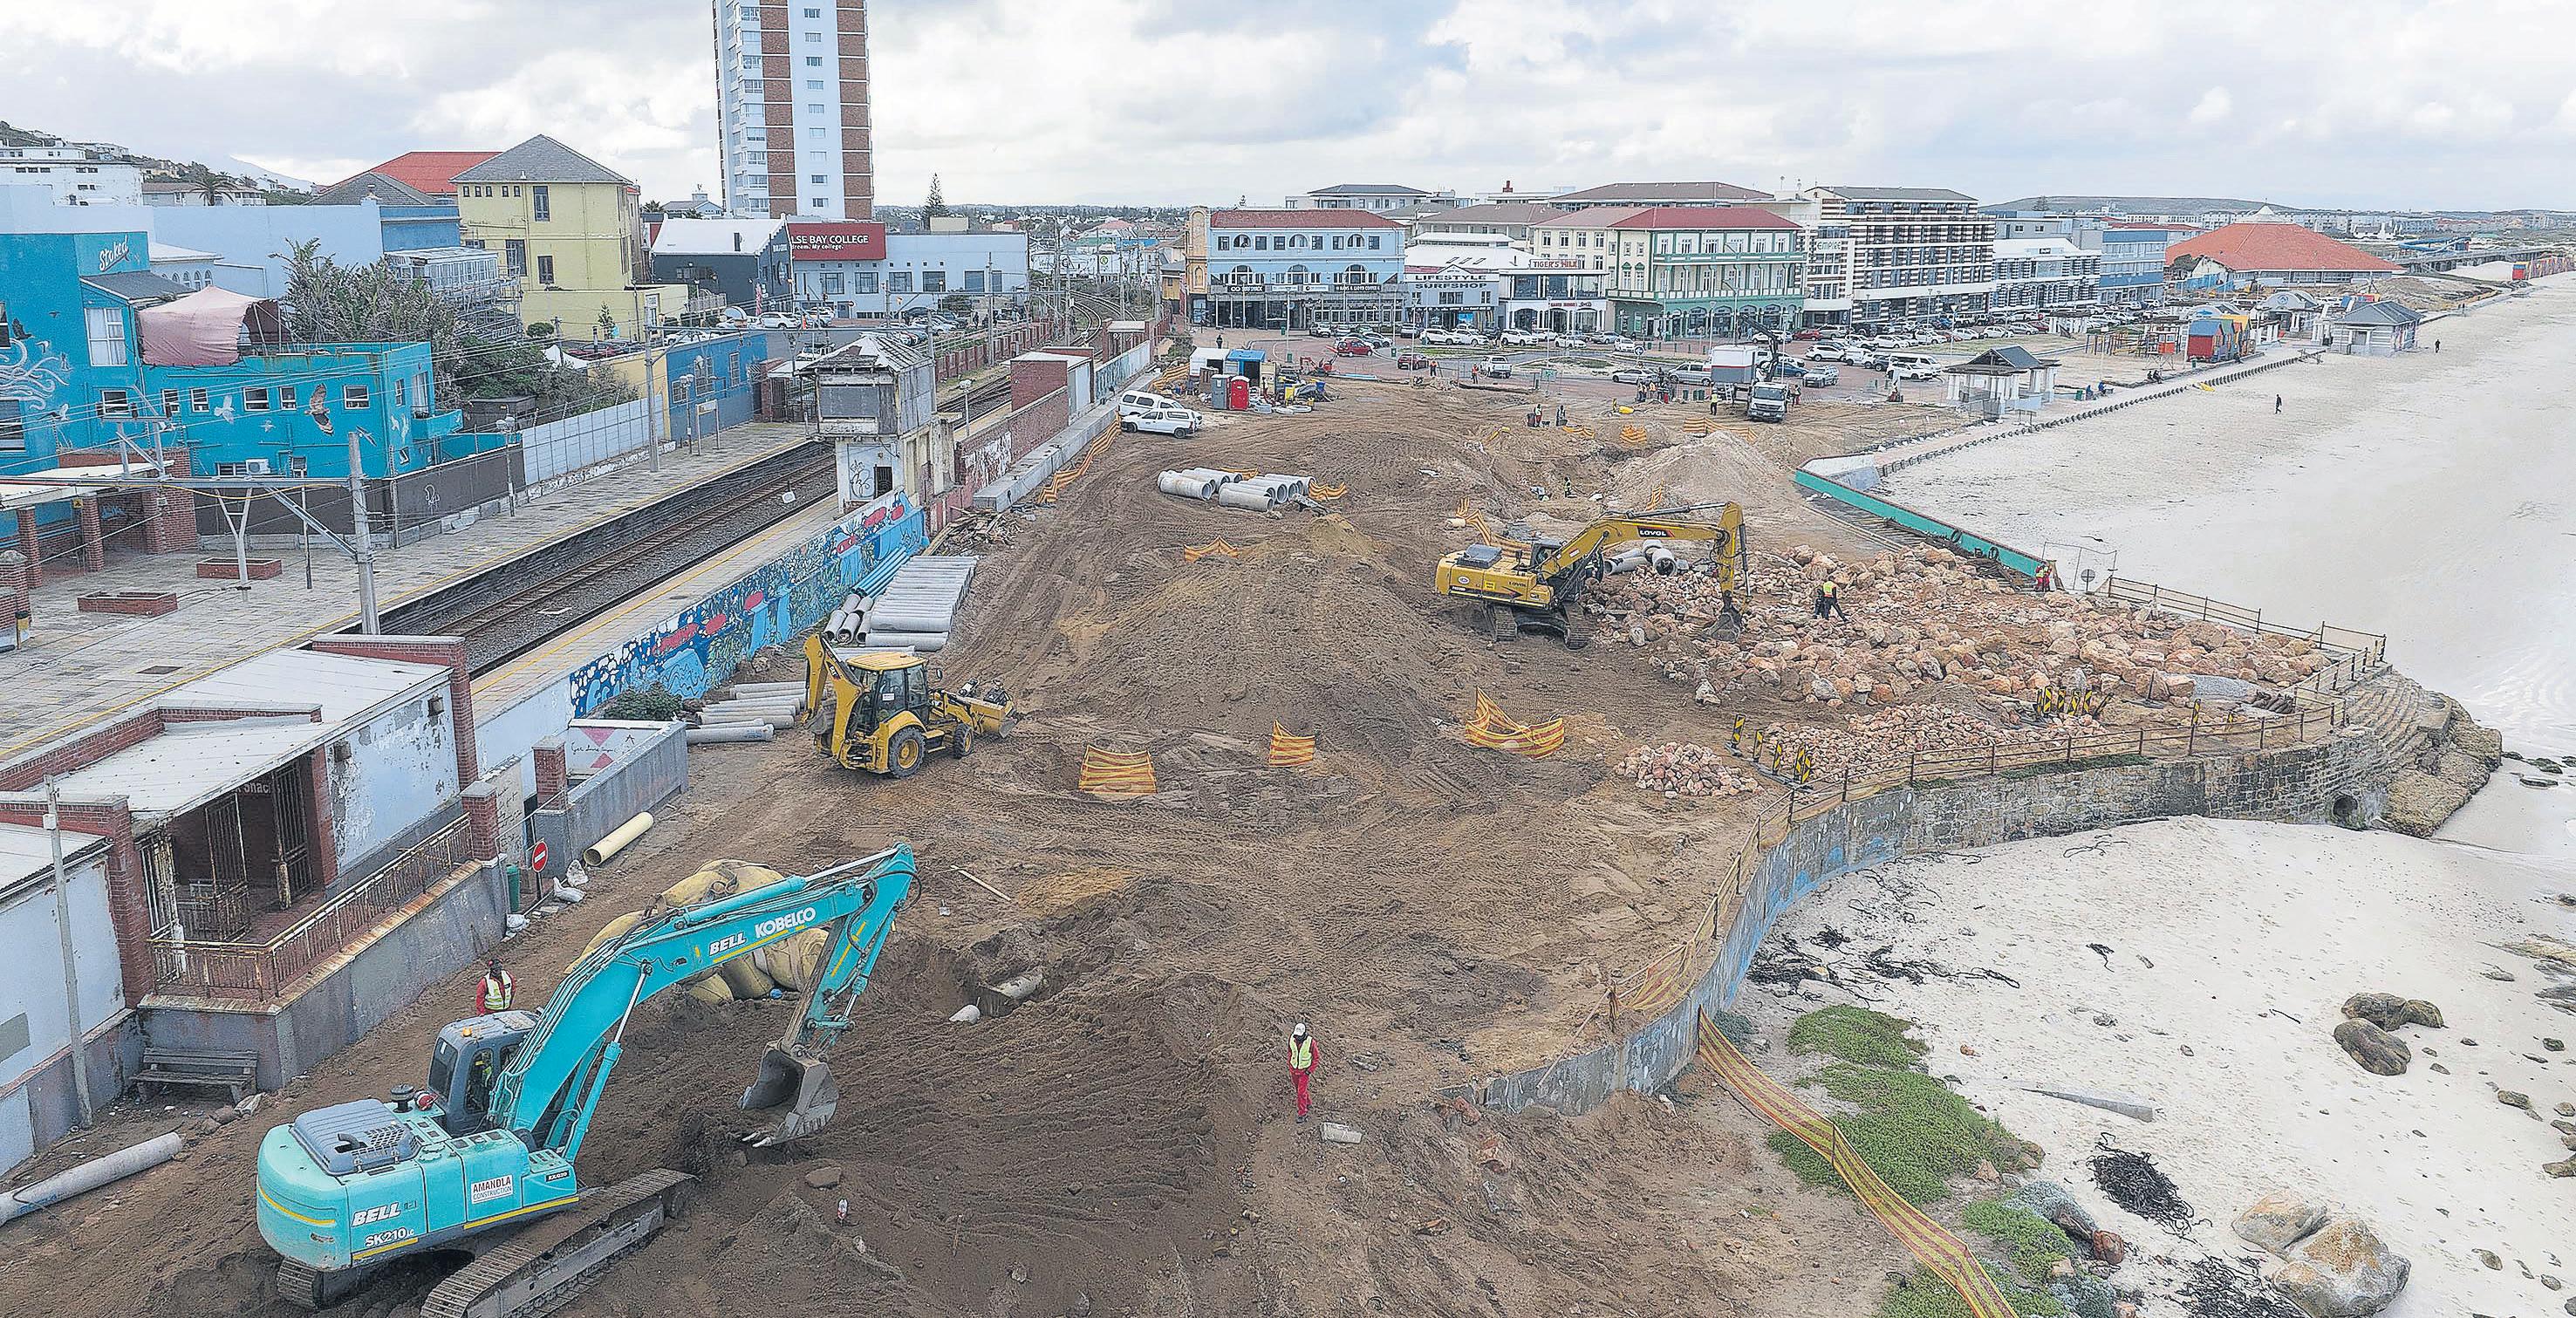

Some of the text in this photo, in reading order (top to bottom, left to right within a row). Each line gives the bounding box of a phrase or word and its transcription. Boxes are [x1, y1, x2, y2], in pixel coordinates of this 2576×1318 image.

[790, 235, 870, 244] LSE BAY COLLEGE
[99, 234, 129, 271] Stoked
[708, 906, 817, 957] BELL KOBELCO
[472, 1176, 511, 1193] AMANDLA
[472, 1186, 513, 1201] CONSTRUCTION
[351, 1202, 401, 1227] BELL
